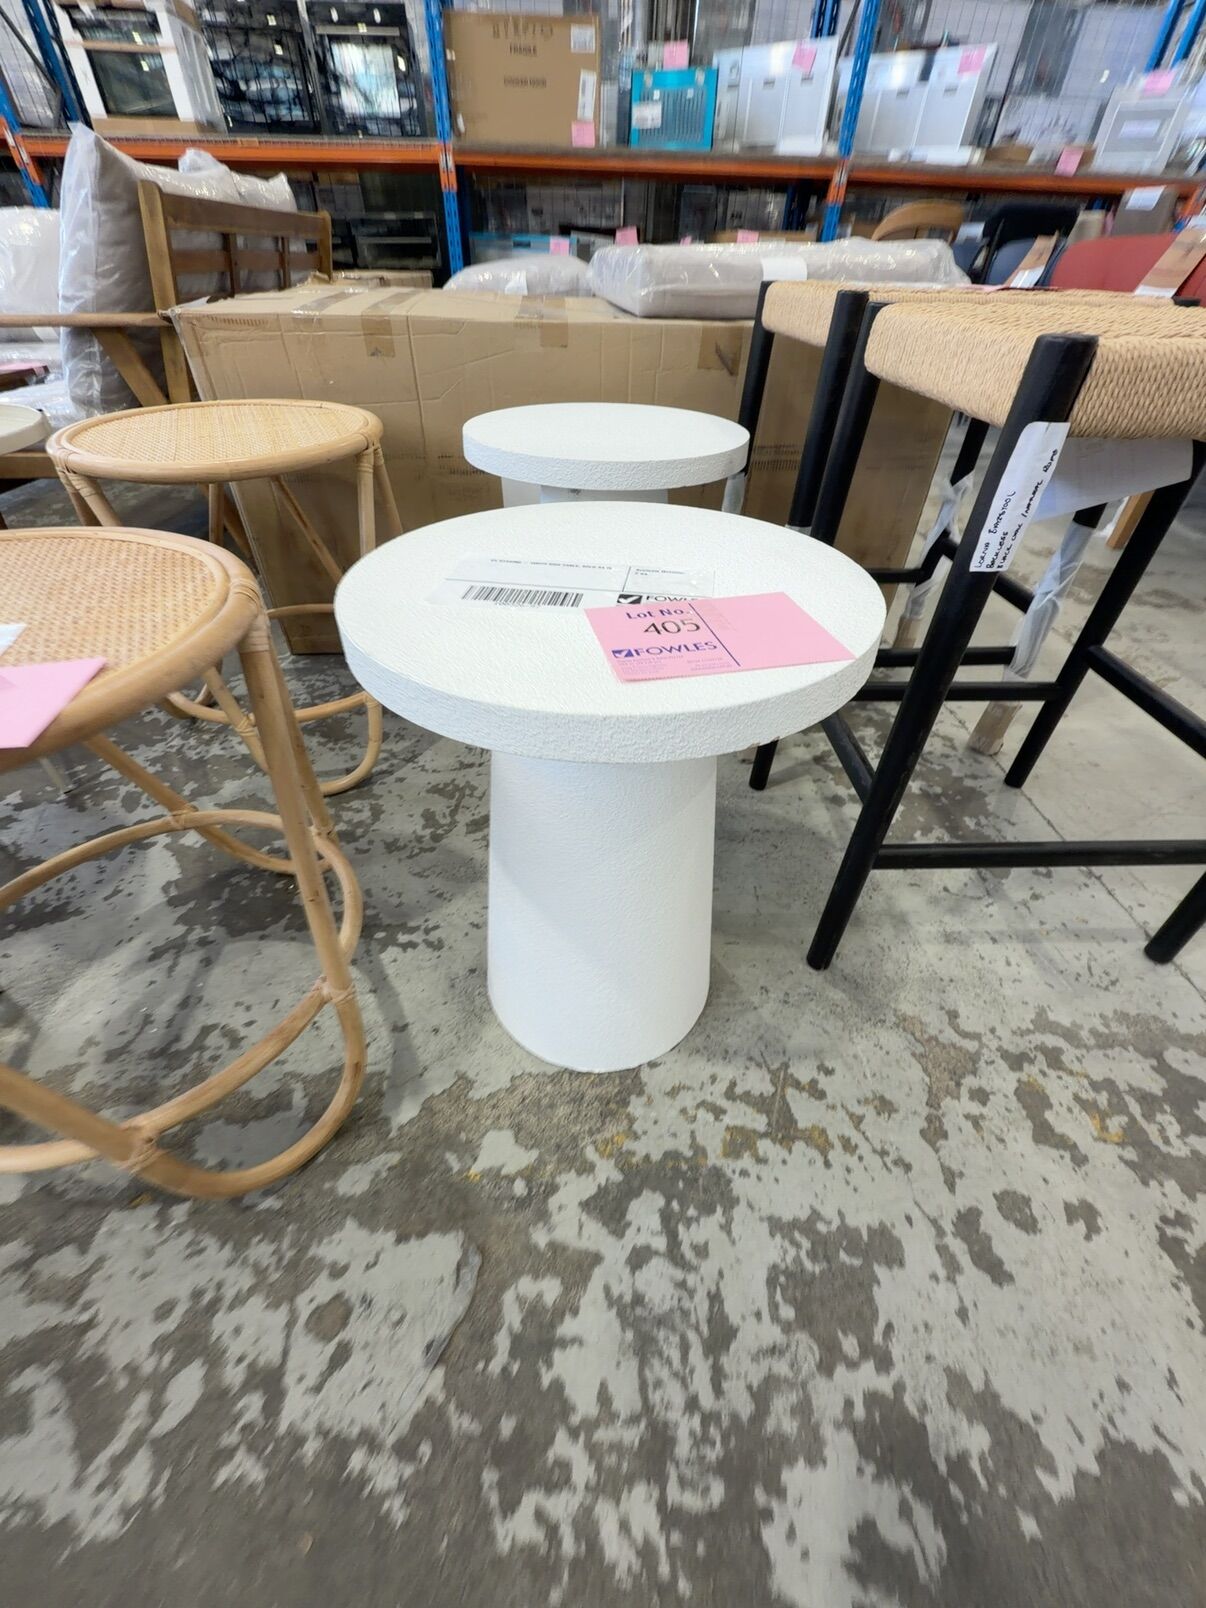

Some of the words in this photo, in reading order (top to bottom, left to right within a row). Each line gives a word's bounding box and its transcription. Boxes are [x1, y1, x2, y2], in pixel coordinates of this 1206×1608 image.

[626, 608, 656, 620] Lot
[659, 607, 691, 617] No.
[643, 618, 700, 636] 405
[633, 641, 718, 657] FOWLES
